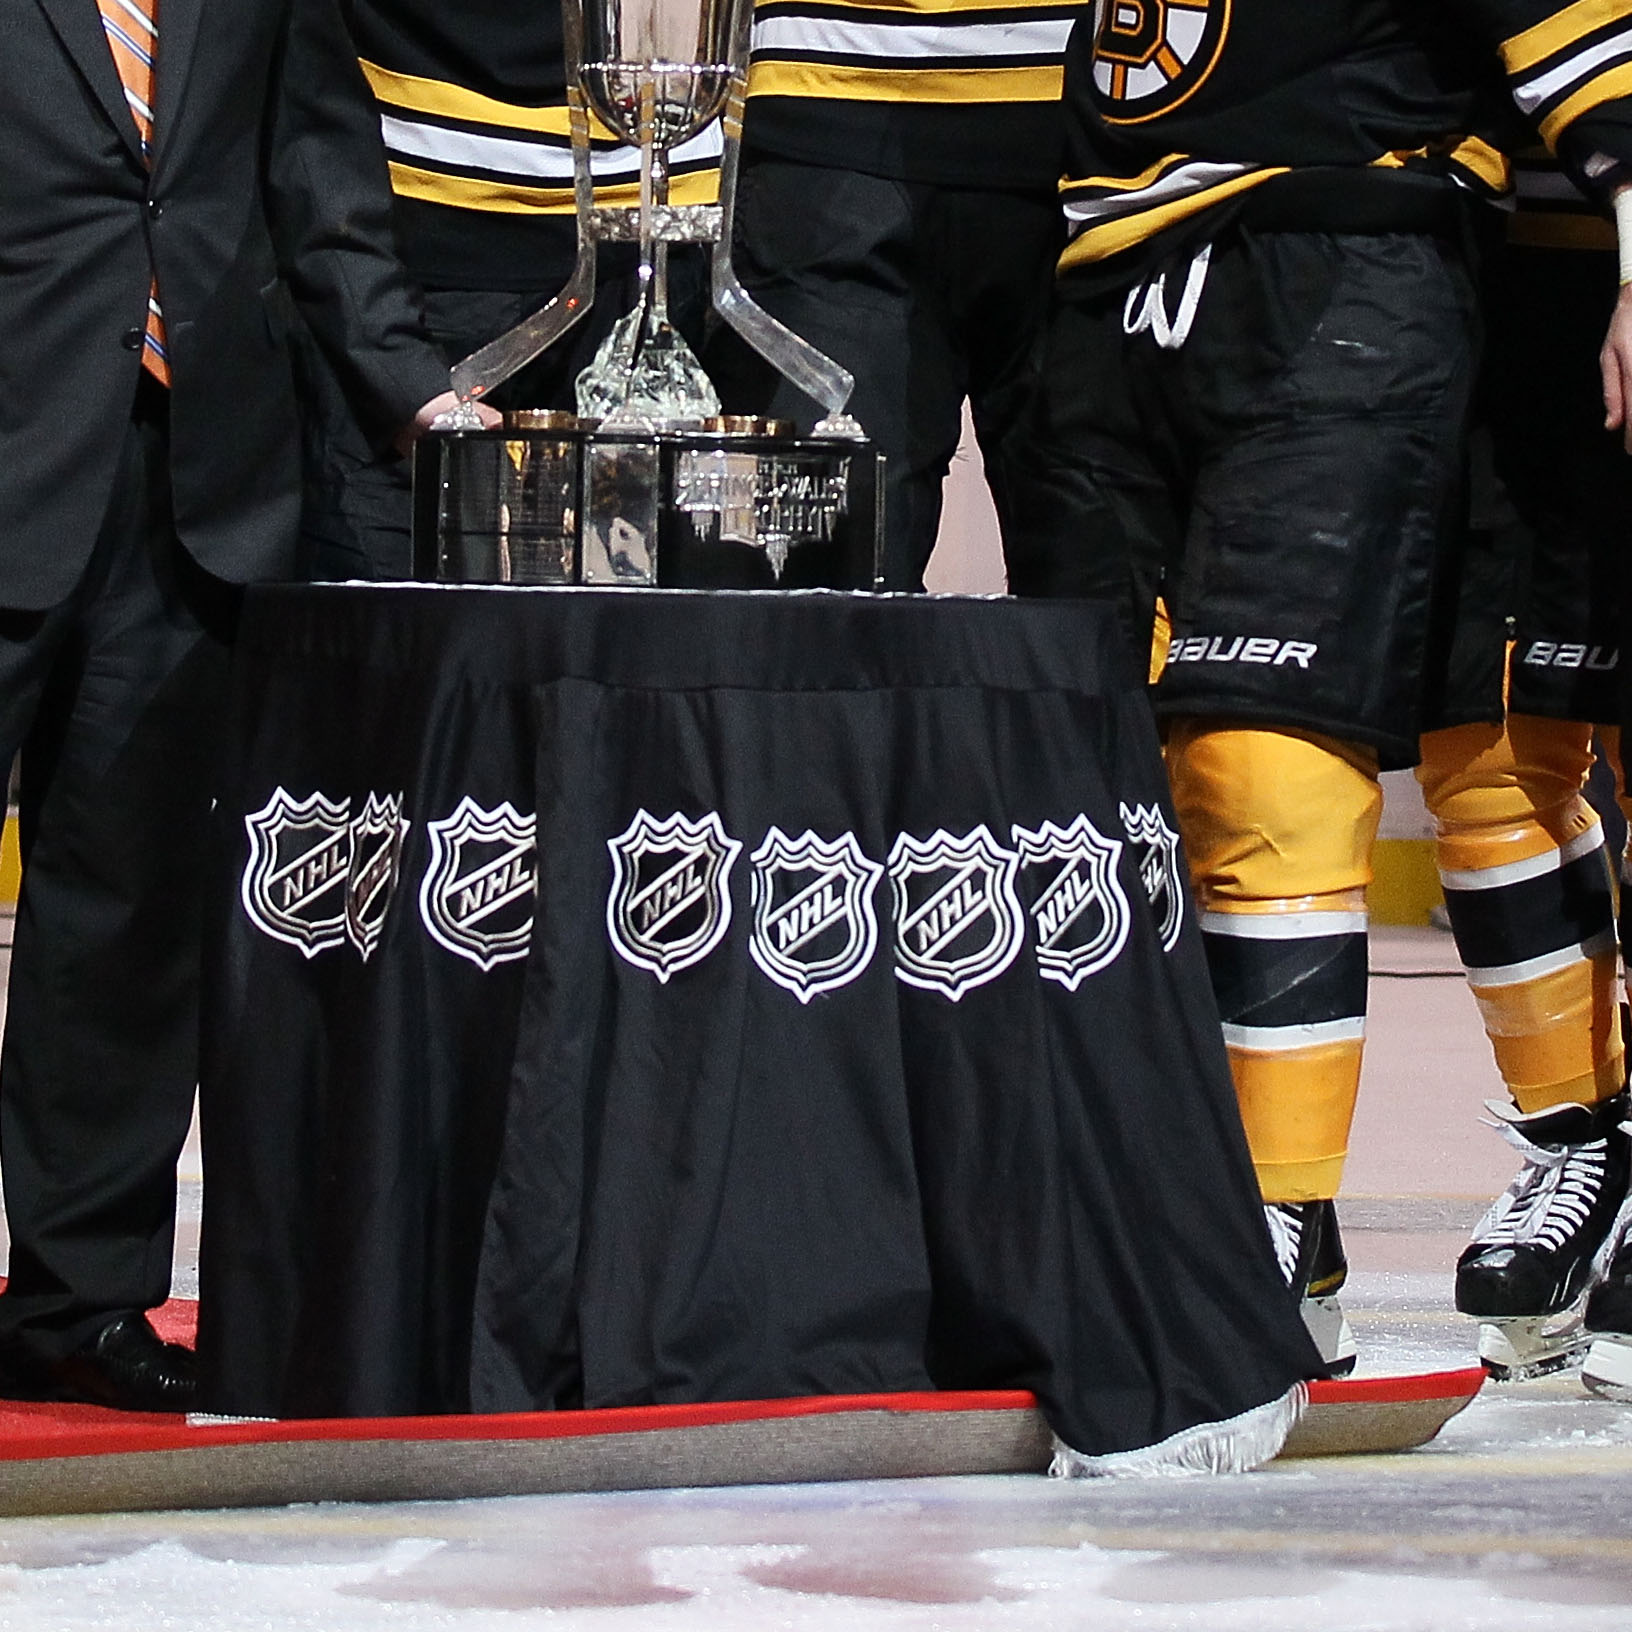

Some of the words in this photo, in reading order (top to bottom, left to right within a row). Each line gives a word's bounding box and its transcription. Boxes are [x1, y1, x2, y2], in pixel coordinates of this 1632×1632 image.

[1522, 640, 1620, 671] BAU
[282, 848, 346, 908] NHL
[457, 856, 536, 918] NHL
[643, 861, 703, 929] NHL
[1035, 867, 1090, 935] NHL
[777, 884, 846, 951] NHL
[917, 878, 984, 952] NHL
